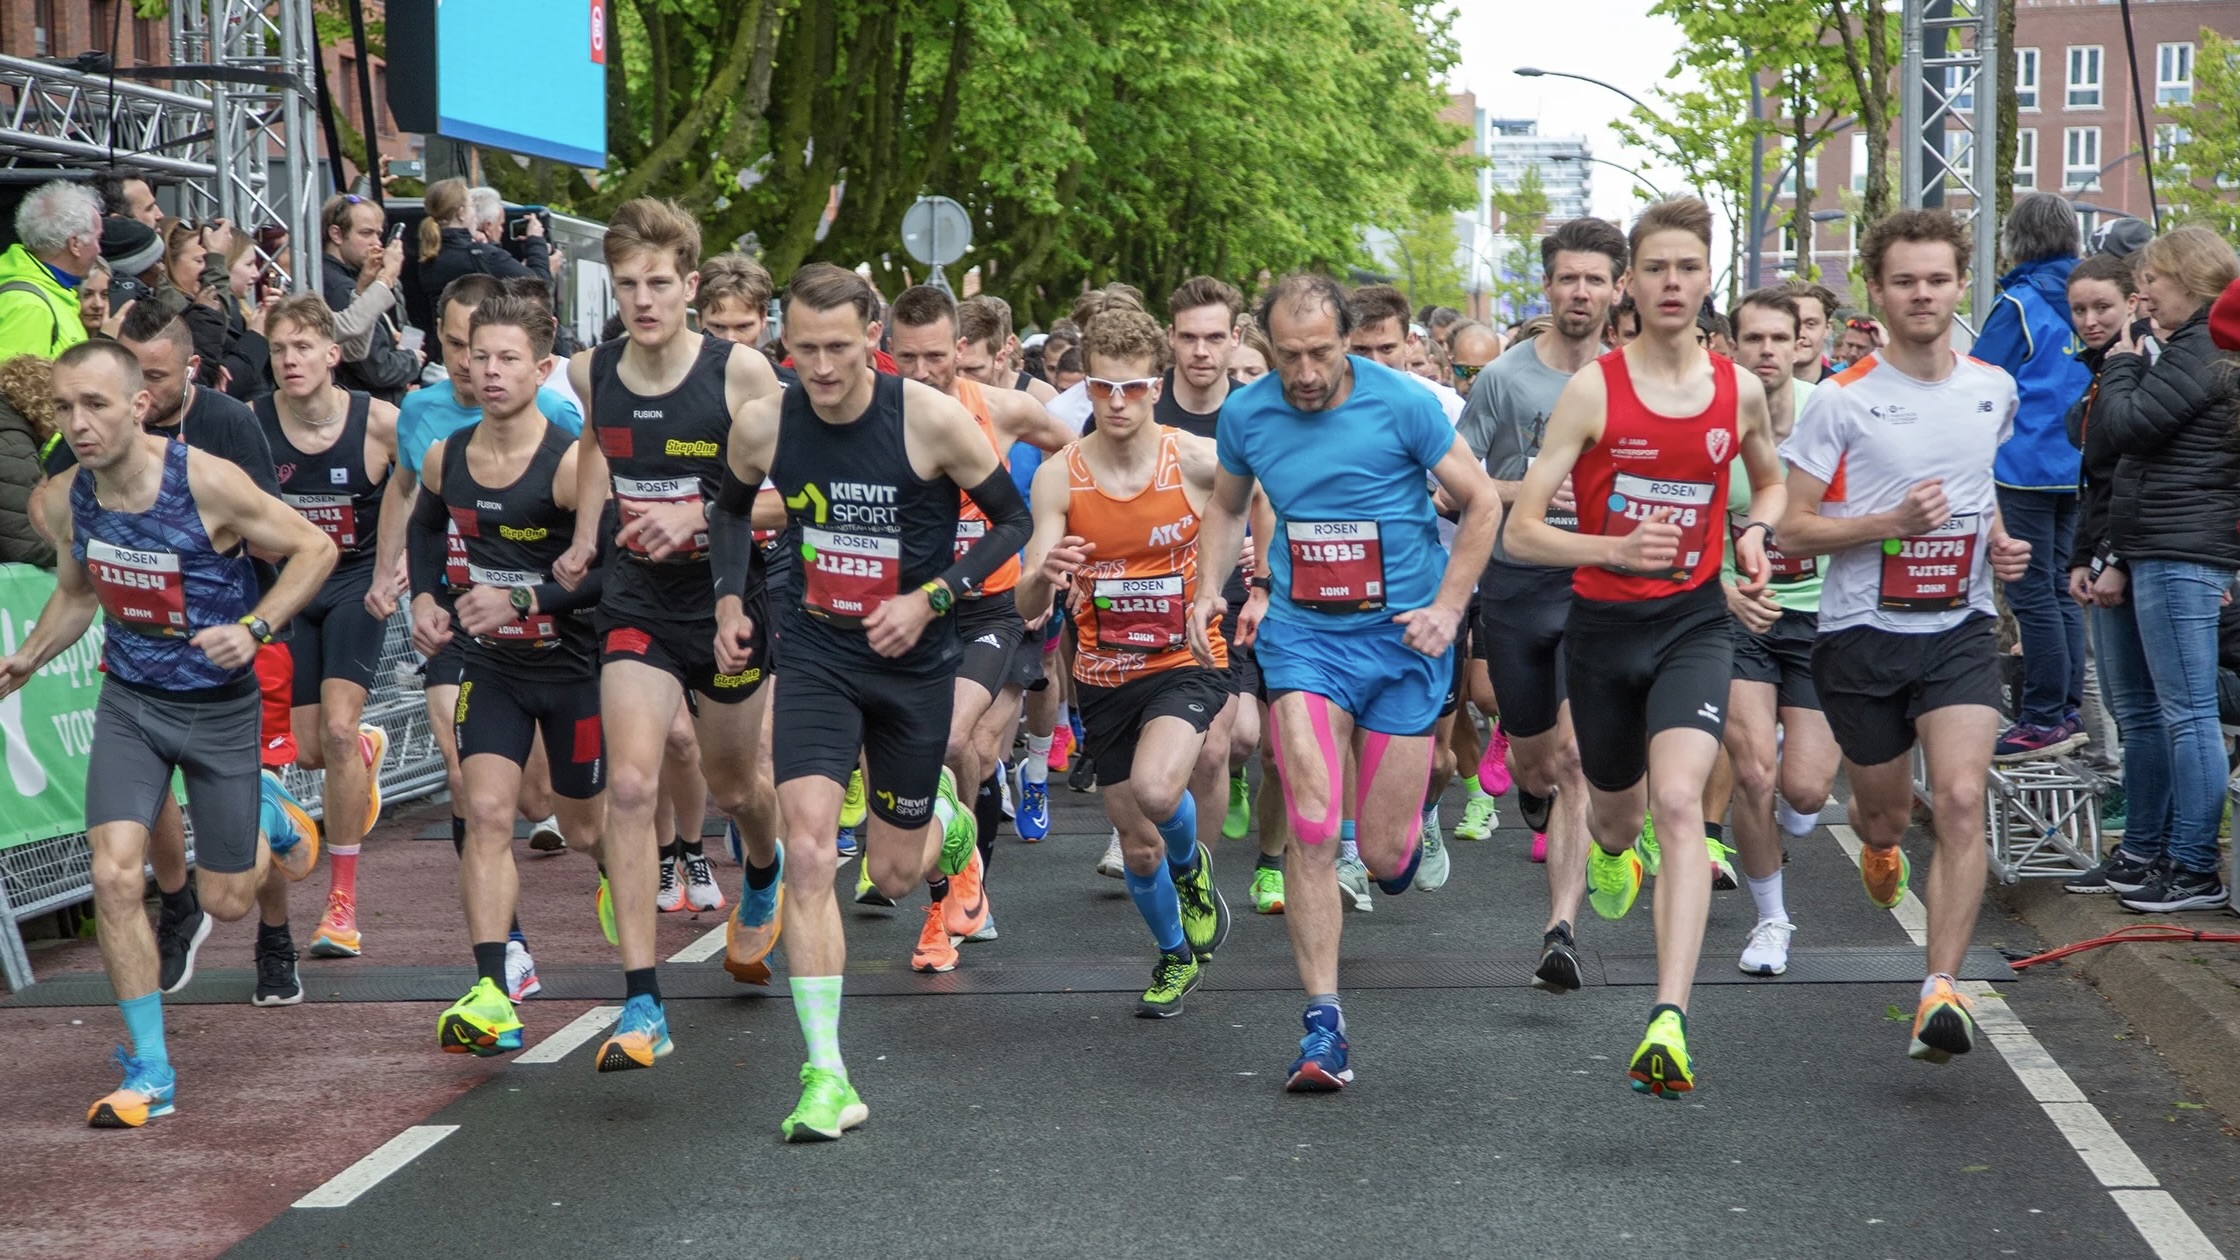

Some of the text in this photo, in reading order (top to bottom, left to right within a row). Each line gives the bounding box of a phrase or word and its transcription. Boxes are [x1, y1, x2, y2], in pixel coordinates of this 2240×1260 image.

[665, 439, 718, 456] Step One
[636, 481, 679, 492] ROSEN
[830, 482, 898, 502] KIEVIT
[1651, 483, 1697, 497] ROSEN
[476, 500, 502, 510] FUSION
[832, 504, 898, 524] SPORT
[500, 526, 547, 540] Step One
[1315, 524, 1358, 535] ROSEN
[833, 535, 879, 549] ROSEN
[1301, 544, 1366, 562] 11935
[1900, 540, 1965, 558] 10778
[115, 549, 158, 565] ROSEN
[816, 553, 883, 578] 11232
[1907, 564, 1958, 577] TJITSE
[100, 565, 165, 590] 11554
[486, 571, 524, 581] ROSEN
[1123, 580, 1164, 591] ROSEN
[1320, 587, 1349, 596] 10KM
[1916, 584, 1946, 594] 10KM
[832, 599, 863, 611] 10KM
[1111, 599, 1170, 613] 11219
[123, 607, 152, 618] 10KM
[498, 625, 523, 634] 10KM
[1128, 632, 1155, 642] 10KM
[897, 796, 929, 808] KIEVIT
[896, 805, 928, 817] SPORT
